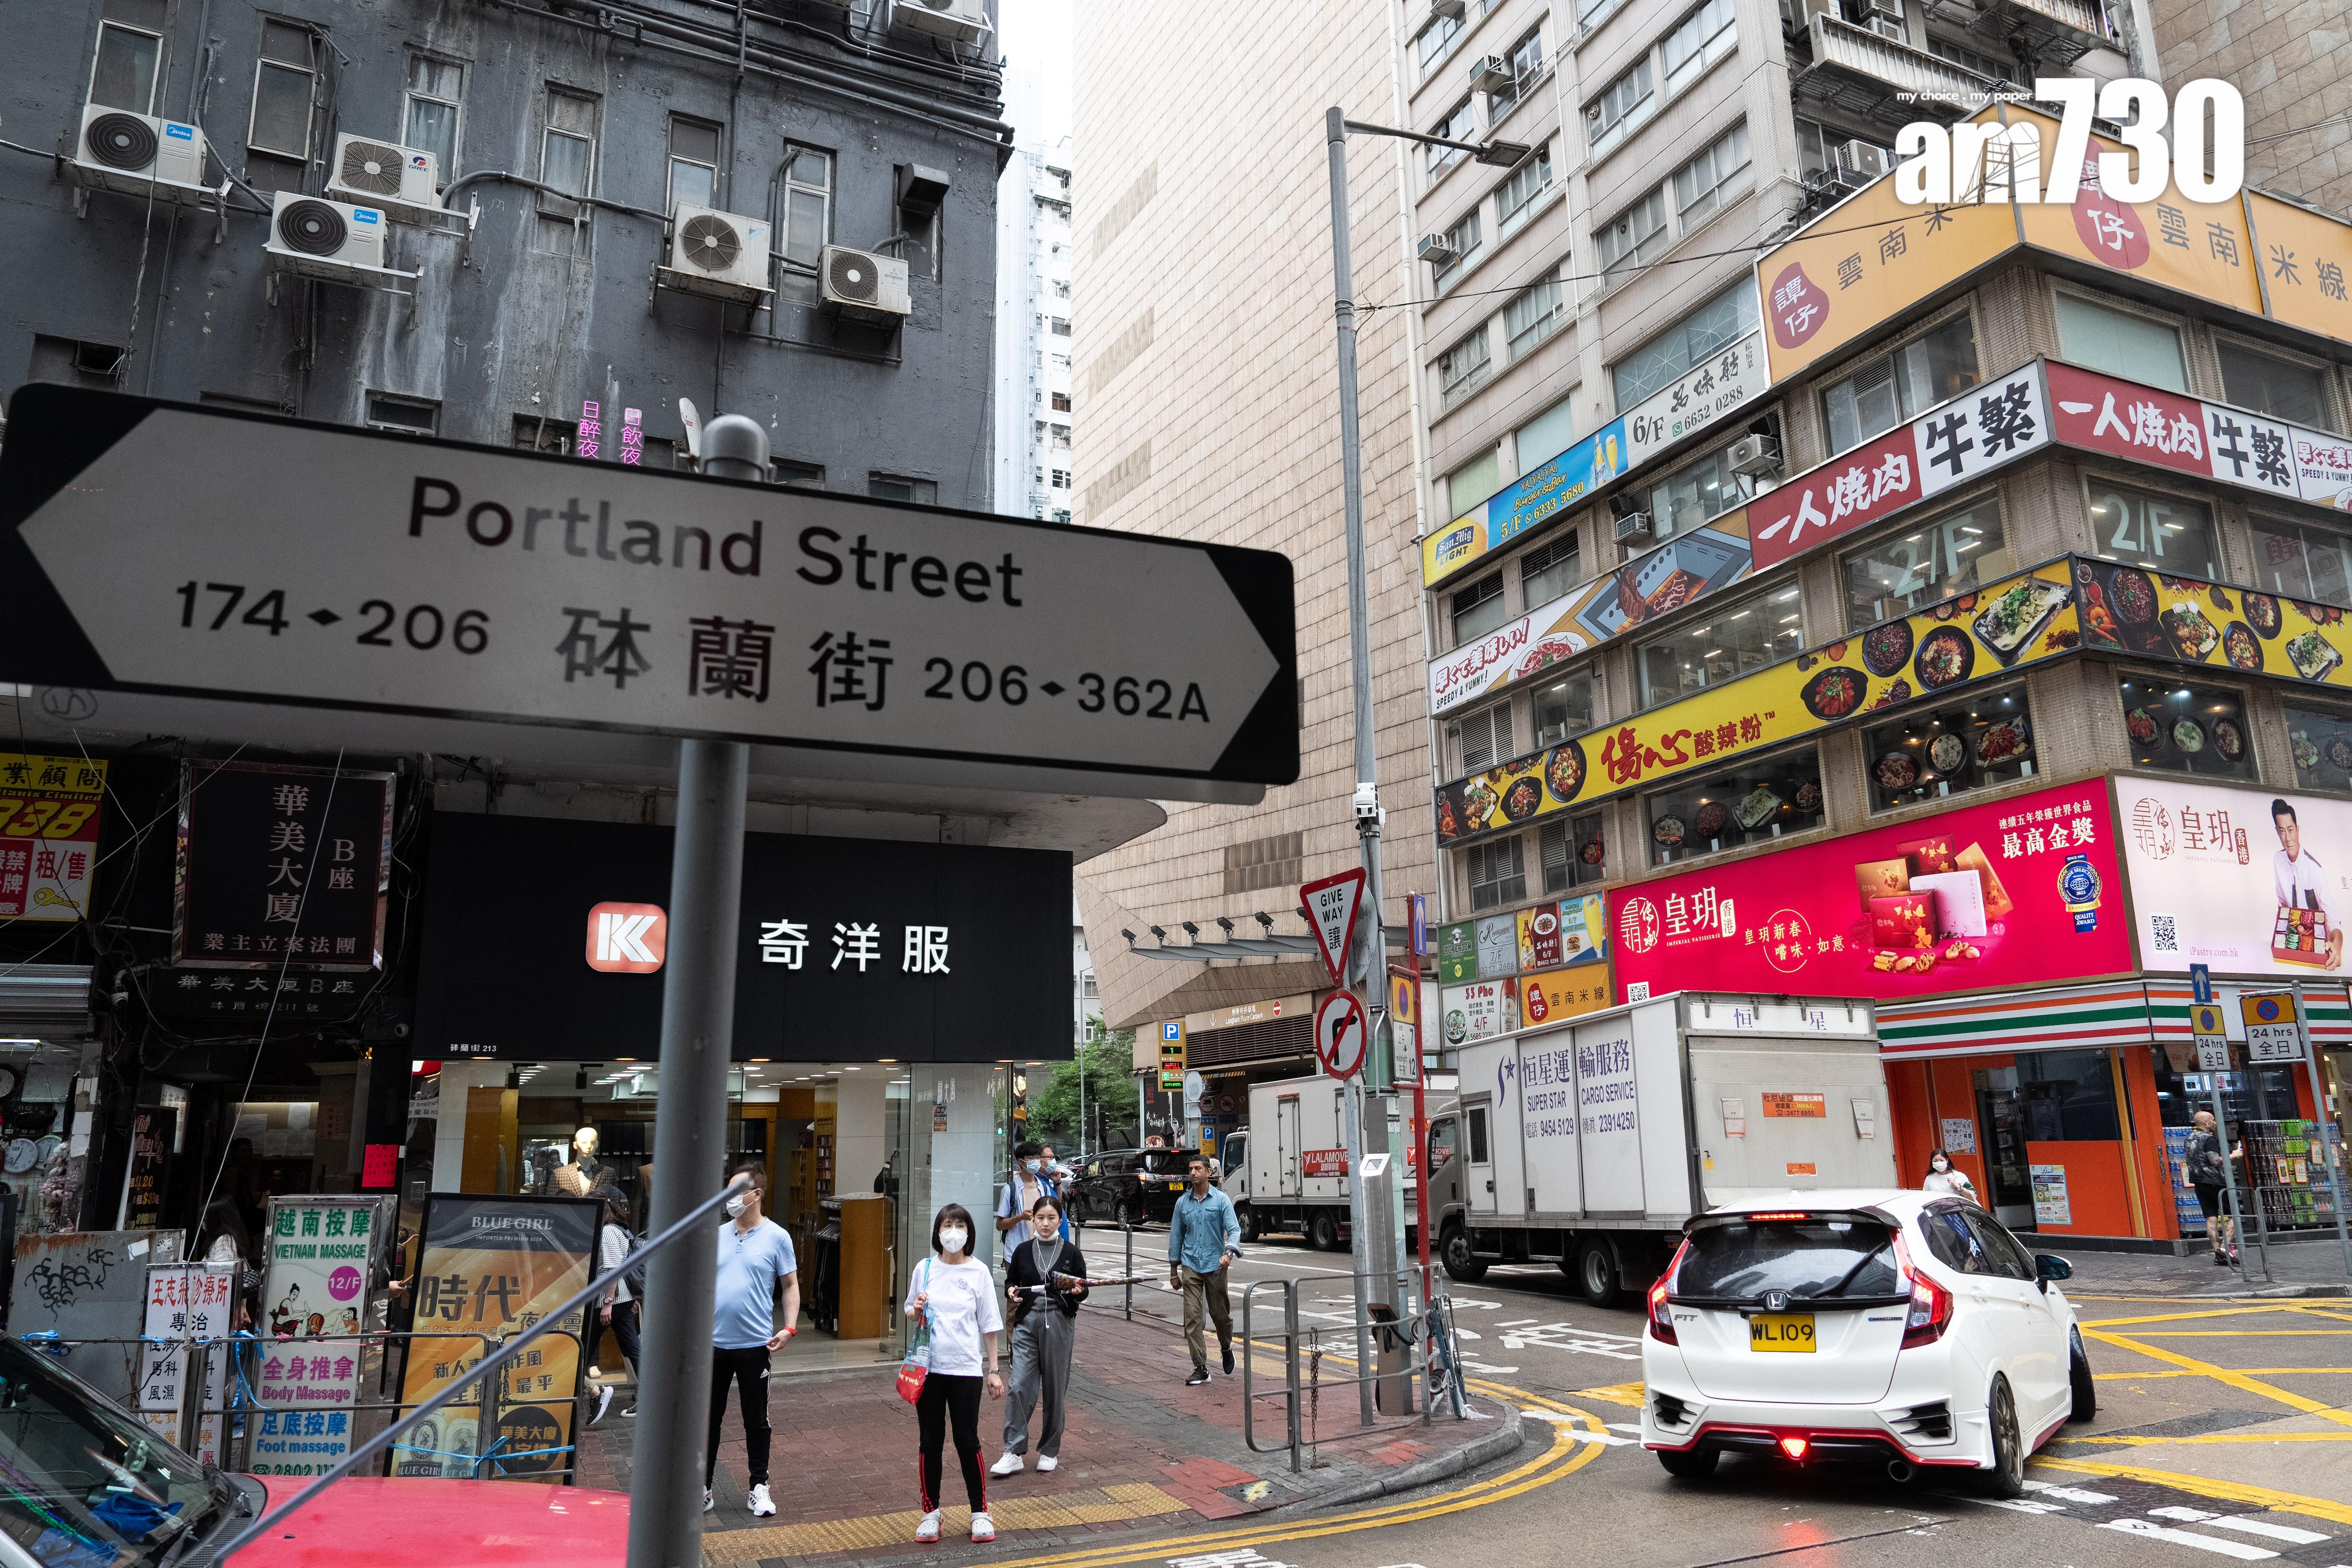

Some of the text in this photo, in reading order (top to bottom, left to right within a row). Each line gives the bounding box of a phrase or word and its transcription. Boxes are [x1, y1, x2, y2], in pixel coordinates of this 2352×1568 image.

[172, 129, 191, 138] Midea
[409, 165, 429, 173] GREE
[360, 213, 377, 222] Midea
[2156, 202, 2350, 302] 雲南米線
[1775, 274, 1820, 337] 譚仔
[1685, 385, 1743, 430] 6652 0288
[578, 401, 601, 459] 日醉夜
[620, 408, 643, 466] 日飲夜
[1633, 415, 1664, 446] 6/F
[1926, 381, 2036, 476] 牛繁
[2211, 411, 2291, 487] 牛繁
[2302, 469, 2323, 480] SPEEDY
[1534, 481, 1584, 520] 6333 5680
[1501, 514, 1521, 539] 5/F
[2111, 494, 2174, 557] 2/F
[408, 474, 1024, 607] Portland Street
[1438, 528, 1471, 556] San Mig
[1440, 546, 1468, 565] LIGHT
[1888, 510, 1975, 599] 2/F
[176, 581, 491, 655] 174 206
[556, 606, 893, 712] 砵蘭街
[923, 656, 1210, 723] 206 362A
[1437, 670, 1488, 709] SPEEDY & YUMMY!
[3, 762, 103, 790] 業顧問
[45, 792, 102, 801] Limited
[1999, 799, 2092, 830] 連續五年榮獲世界食品
[2002, 816, 2096, 859] 最高金獎
[2181, 805, 2233, 853] 皇玥
[264, 784, 309, 923] 華美大廈
[2235, 830, 2249, 863] 香港
[35, 850, 87, 880] 租/售
[328, 839, 355, 889] B座
[2064, 868, 2095, 888] MONDE SELECTION
[1320, 888, 1343, 906] GIVE
[1322, 904, 1343, 923] WAY
[1666, 886, 1718, 936] 皇玥
[1722, 902, 1733, 934] 香港
[2075, 912, 2094, 921] QUALITY
[1328, 927, 1342, 950] 讓
[1667, 934, 1721, 947] IMPERIAL PATISSERIE
[1745, 920, 1802, 945] 皇玥新春
[203, 933, 356, 954] 業主立案法團
[758, 919, 951, 974] 奇洋服
[2189, 947, 2239, 958] iPastry.com.hk
[1491, 950, 1502, 962] 7/F
[1481, 962, 1514, 974] 2312 2608
[1478, 985, 1494, 998] Pho
[1551, 987, 1604, 1006] 雲南米線
[1530, 990, 1545, 1017] 譚仔
[1250, 1012, 1263, 1021] Carpark
[1474, 1017, 1487, 1030] 4/F
[1734, 1008, 1828, 1030] 恒星
[1167, 1025, 1176, 1038] P
[1398, 1028, 1414, 1045] 上午 7
[2252, 1028, 2292, 1038] 24 hrs
[2199, 1038, 2223, 1048] 24 hrs
[2258, 1040, 2290, 1055] 全日
[1396, 1054, 1407, 1064] midnight
[1409, 1057, 1415, 1075] 12
[2204, 1052, 2224, 1066] 全日
[1527, 1081, 1634, 1112] SUPER STAR CARGO SERVICE
[1541, 1117, 1573, 1137] 9454 5129
[1599, 1111, 1635, 1132] 23914250
[1311, 1151, 1348, 1164] LALAMOVE
[275, 1209, 371, 1237] 越南按摩
[472, 1217, 552, 1230] BLUE GIRL
[275, 1244, 366, 1259] VIETNAM MASSAGE
[330, 1275, 360, 1289] 12/F
[419, 1275, 522, 1323] 時代
[169, 1312, 208, 1331] 專治
[1751, 1323, 1813, 1341] WL109
[263, 1356, 355, 1381] 全身推拿
[262, 1386, 350, 1402] Body Massage
[260, 1413, 347, 1436] 足底按摩
[501, 1426, 557, 1440] 華美大廈
[257, 1439, 346, 1456] Foot massage
[397, 1466, 419, 1475] BLUE
